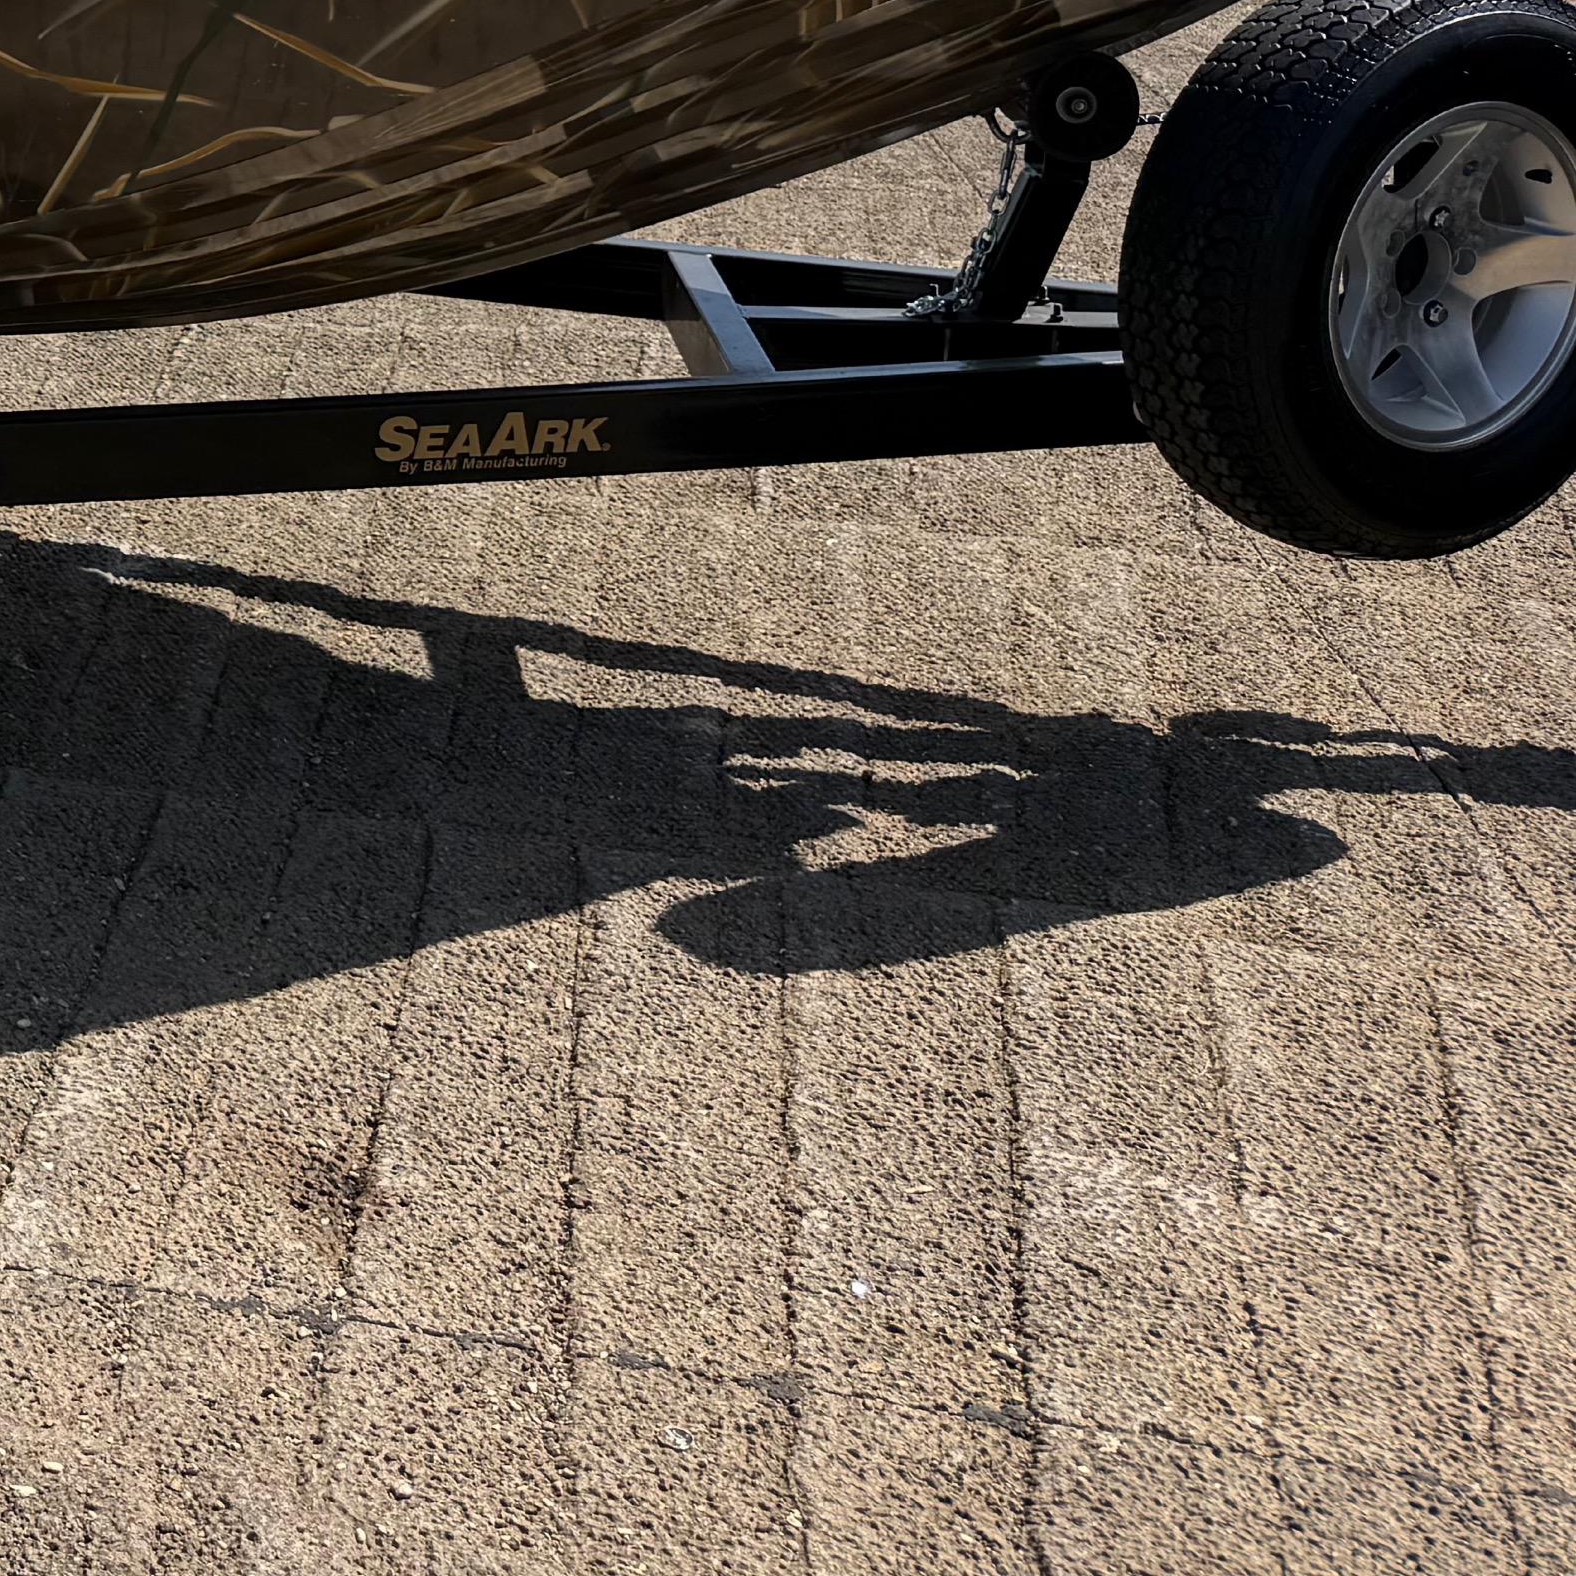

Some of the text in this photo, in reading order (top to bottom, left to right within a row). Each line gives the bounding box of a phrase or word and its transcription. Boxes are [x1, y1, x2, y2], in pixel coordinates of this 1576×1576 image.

[399, 454, 567, 475] By B&M Manufacturing
